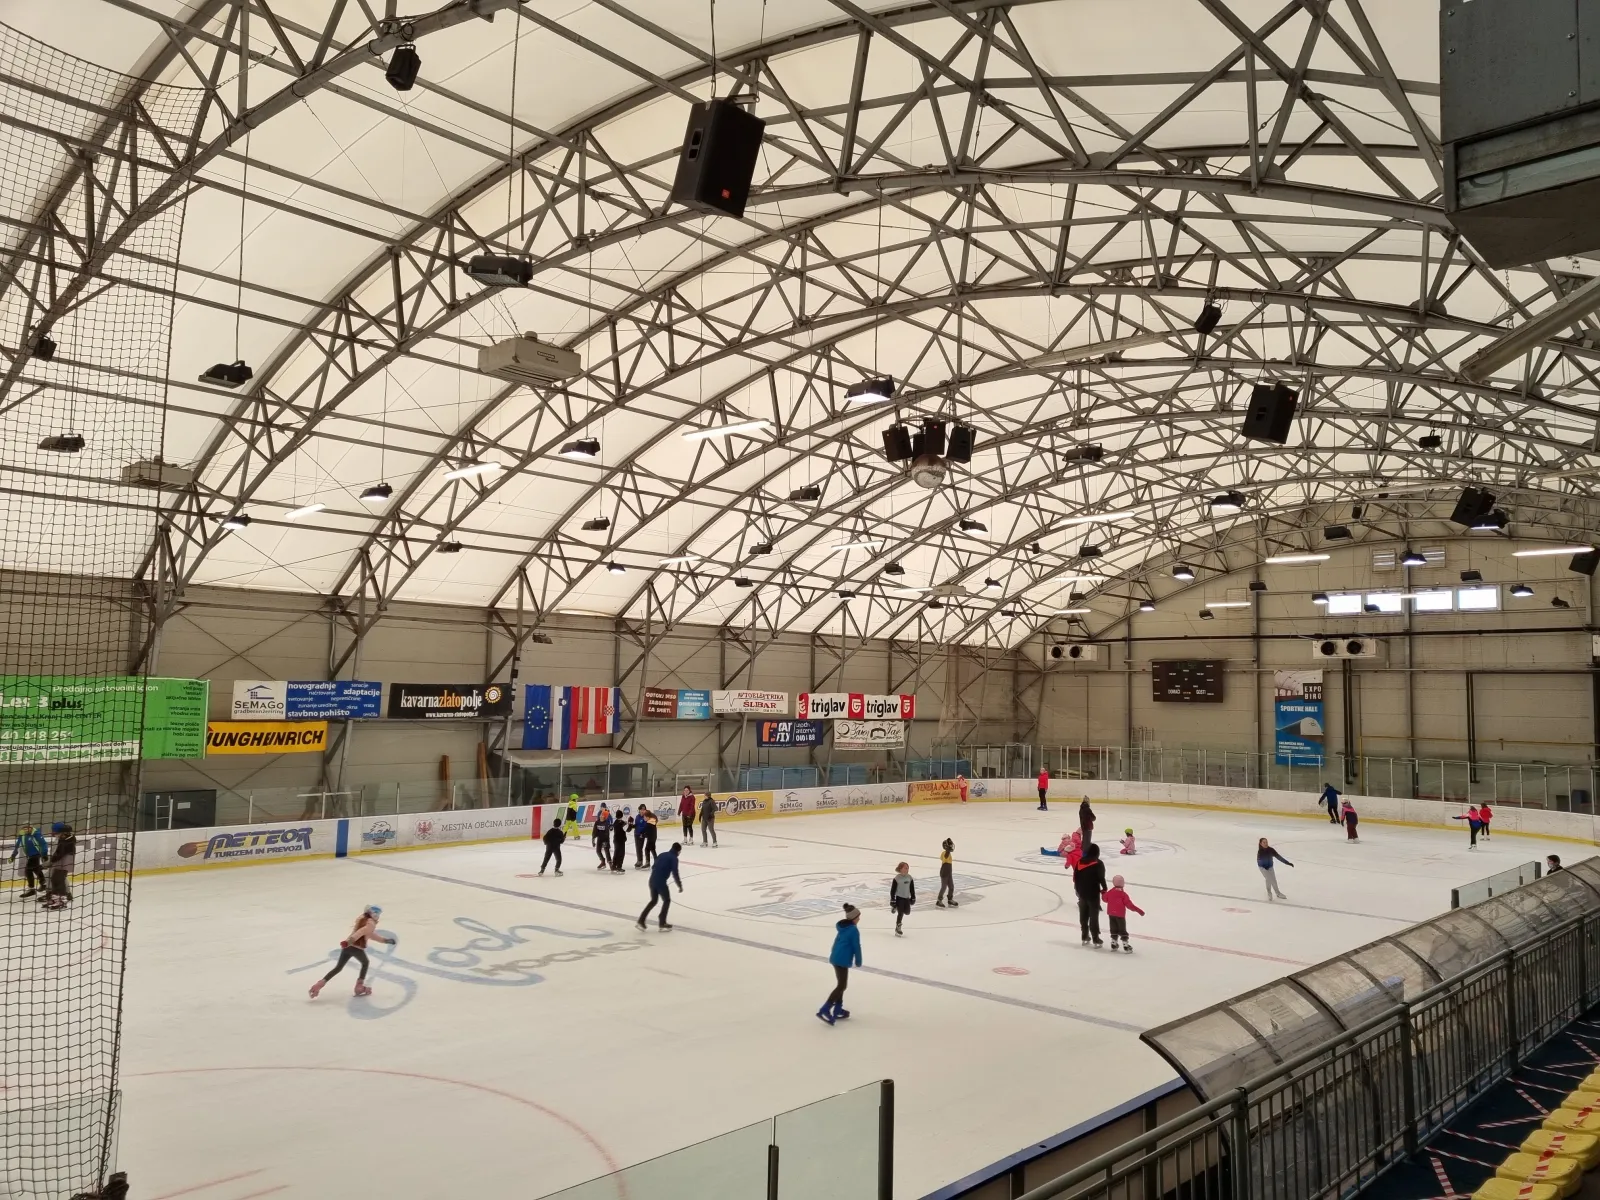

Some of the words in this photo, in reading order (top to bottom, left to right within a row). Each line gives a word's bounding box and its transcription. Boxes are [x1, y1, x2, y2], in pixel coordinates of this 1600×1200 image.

[288, 682, 337, 691] novogradnje
[343, 687, 381, 697] adaptacije
[287, 709, 319, 718] stavbno
[811, 697, 846, 717] triglav
[866, 699, 899, 718] triglav
[441, 822, 472, 832] MESTNA
[475, 819, 503, 829] OBČINA
[504, 817, 527, 827] KRANJ
[204, 827, 314, 860] METEOR
[214, 849, 253, 859] TURIZEM
[267, 845, 303, 854] PREVOZI
